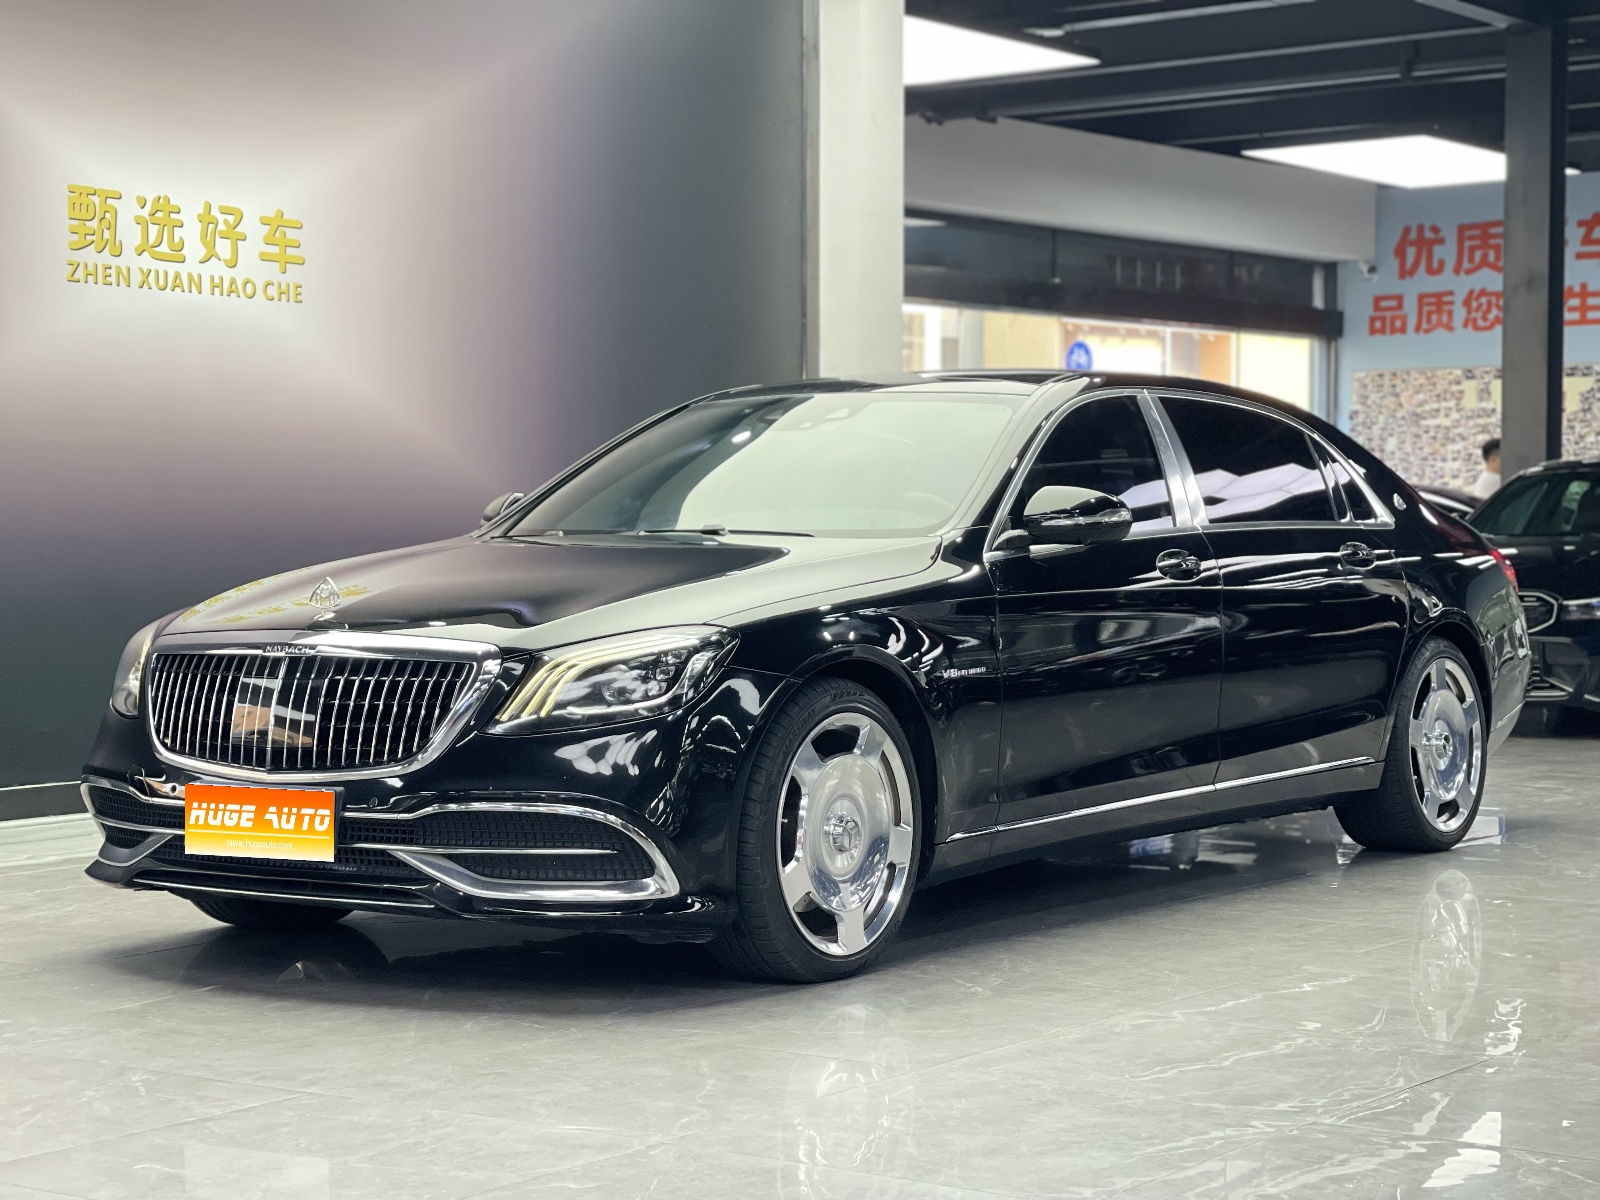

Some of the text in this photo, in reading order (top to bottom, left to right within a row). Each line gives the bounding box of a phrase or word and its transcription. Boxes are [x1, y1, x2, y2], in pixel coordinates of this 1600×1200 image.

[66, 183, 305, 274] 甄选好车
[66, 259, 303, 304] ZHEN XUAN HAO CHE
[265, 644, 310, 654] MAYBACH
